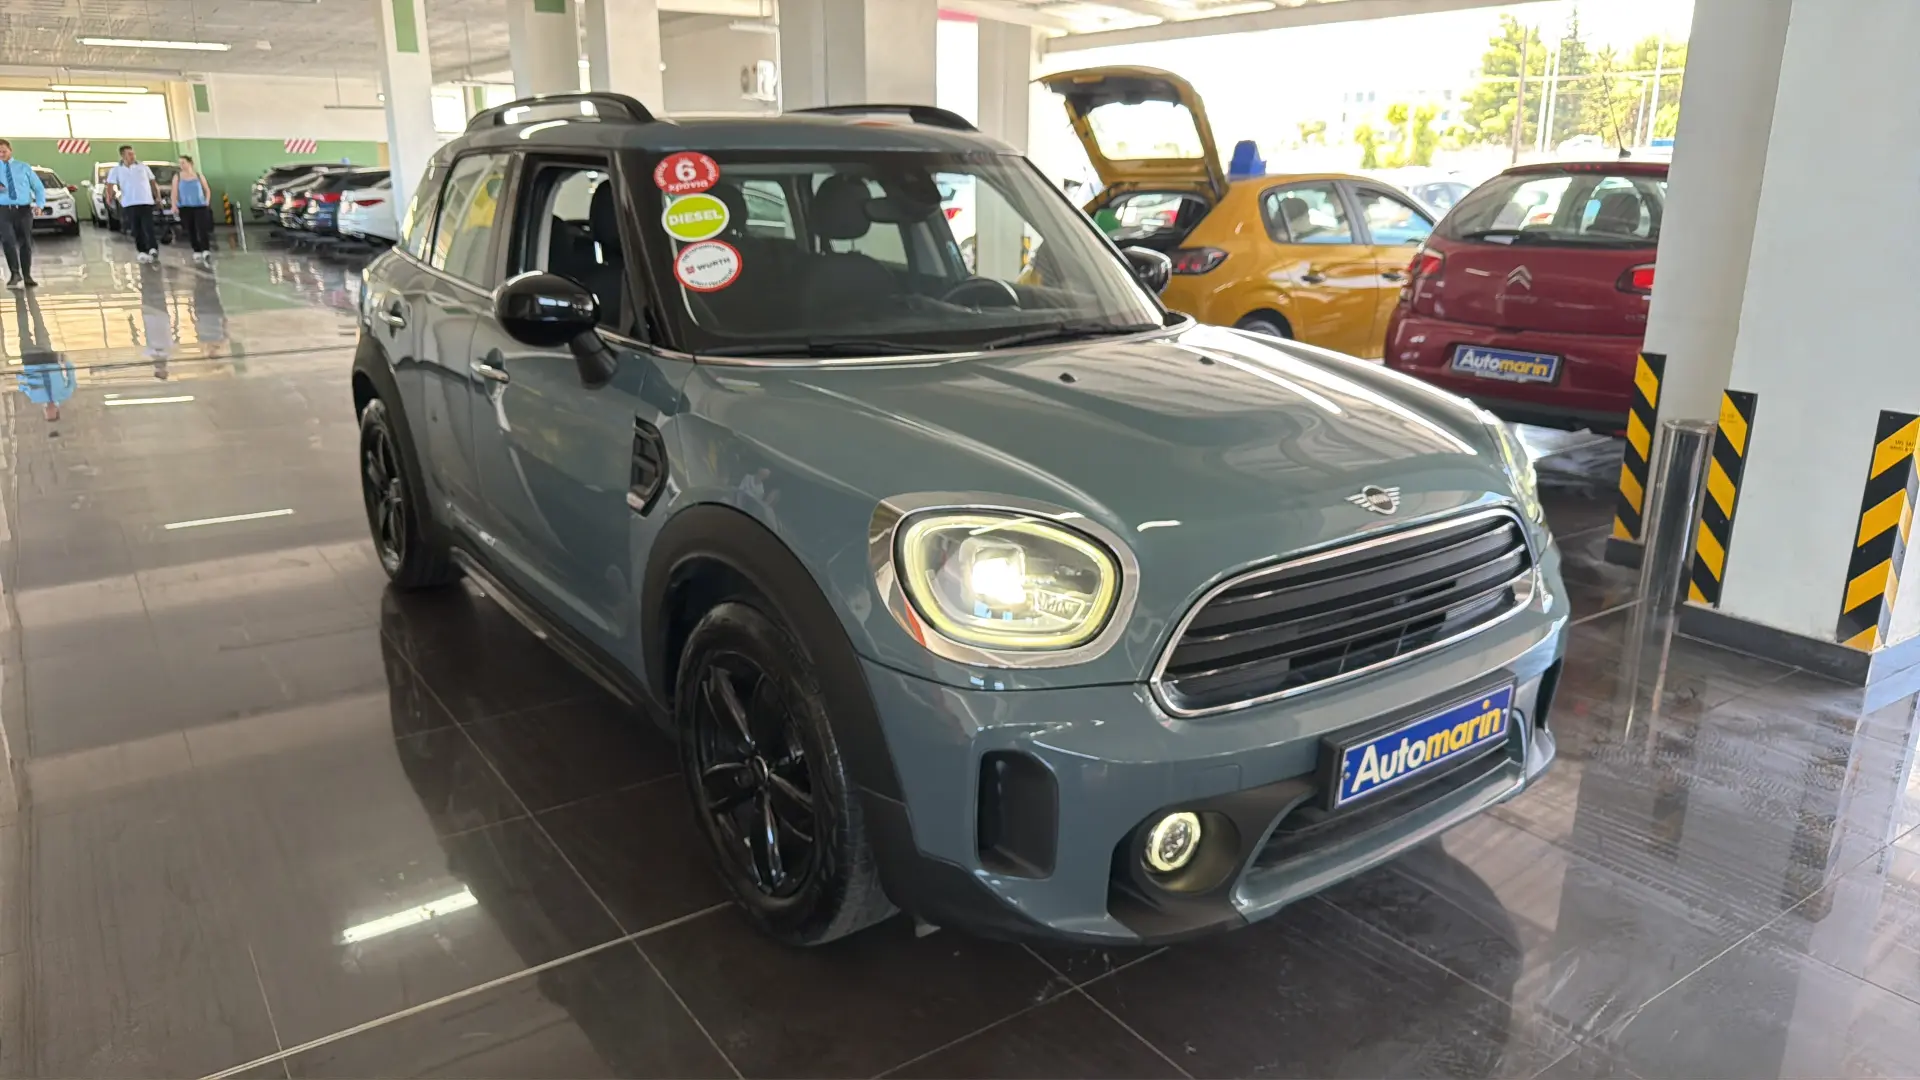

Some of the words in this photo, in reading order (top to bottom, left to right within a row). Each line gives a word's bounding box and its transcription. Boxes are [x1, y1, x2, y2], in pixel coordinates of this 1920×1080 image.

[675, 158, 697, 182] 6
[668, 208, 723, 226] DIESEL
[1459, 348, 1549, 376] Automarin
[1351, 699, 1501, 793] Automarin
